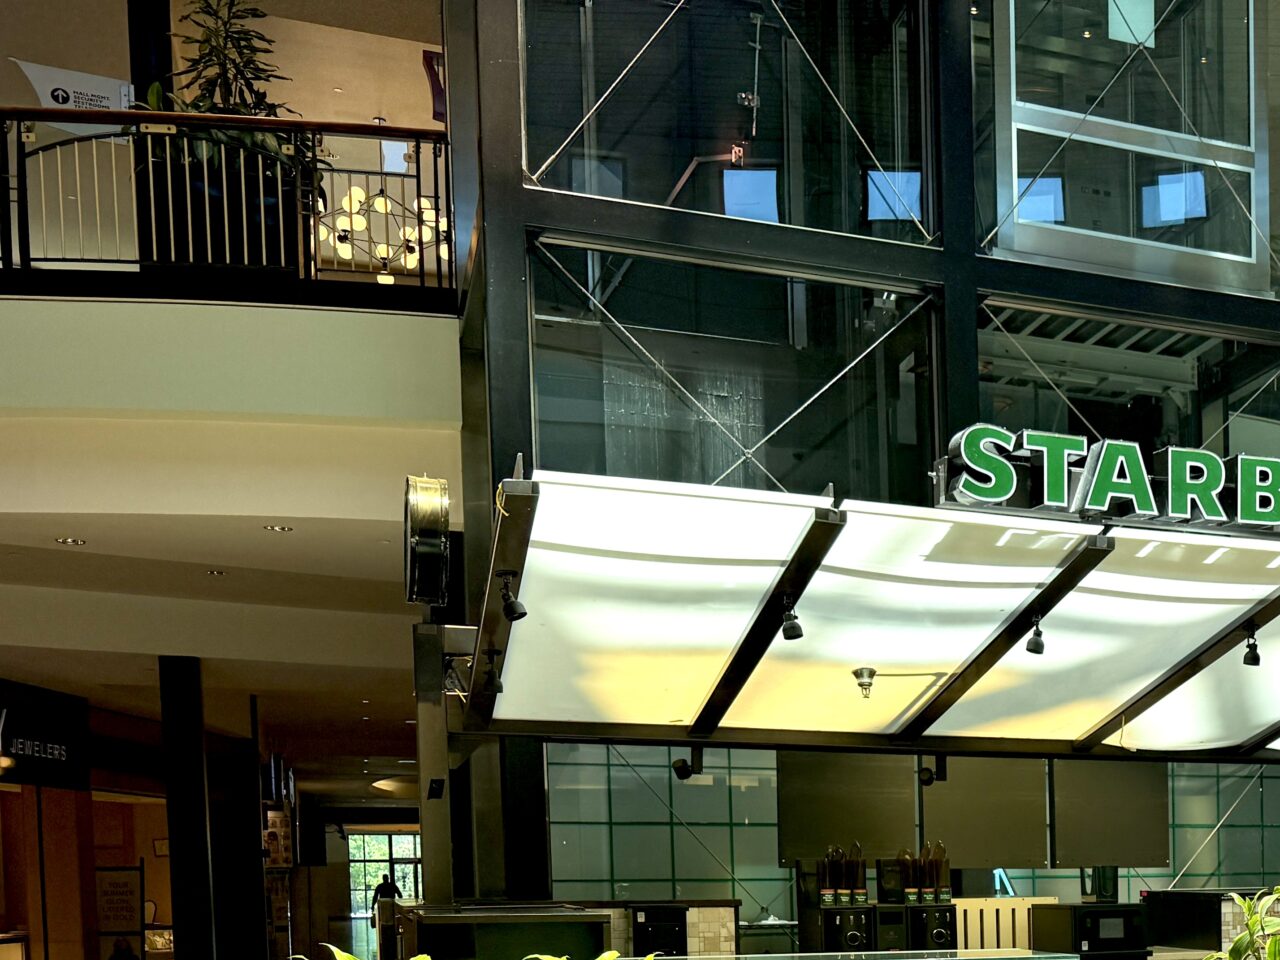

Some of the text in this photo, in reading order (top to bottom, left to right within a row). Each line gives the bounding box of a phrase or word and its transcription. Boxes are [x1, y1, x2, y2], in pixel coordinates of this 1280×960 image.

[73, 95, 103, 104] SECURITY
[73, 100, 111, 110] RESTROOMS
[10, 738, 66, 761] JEWELERS
